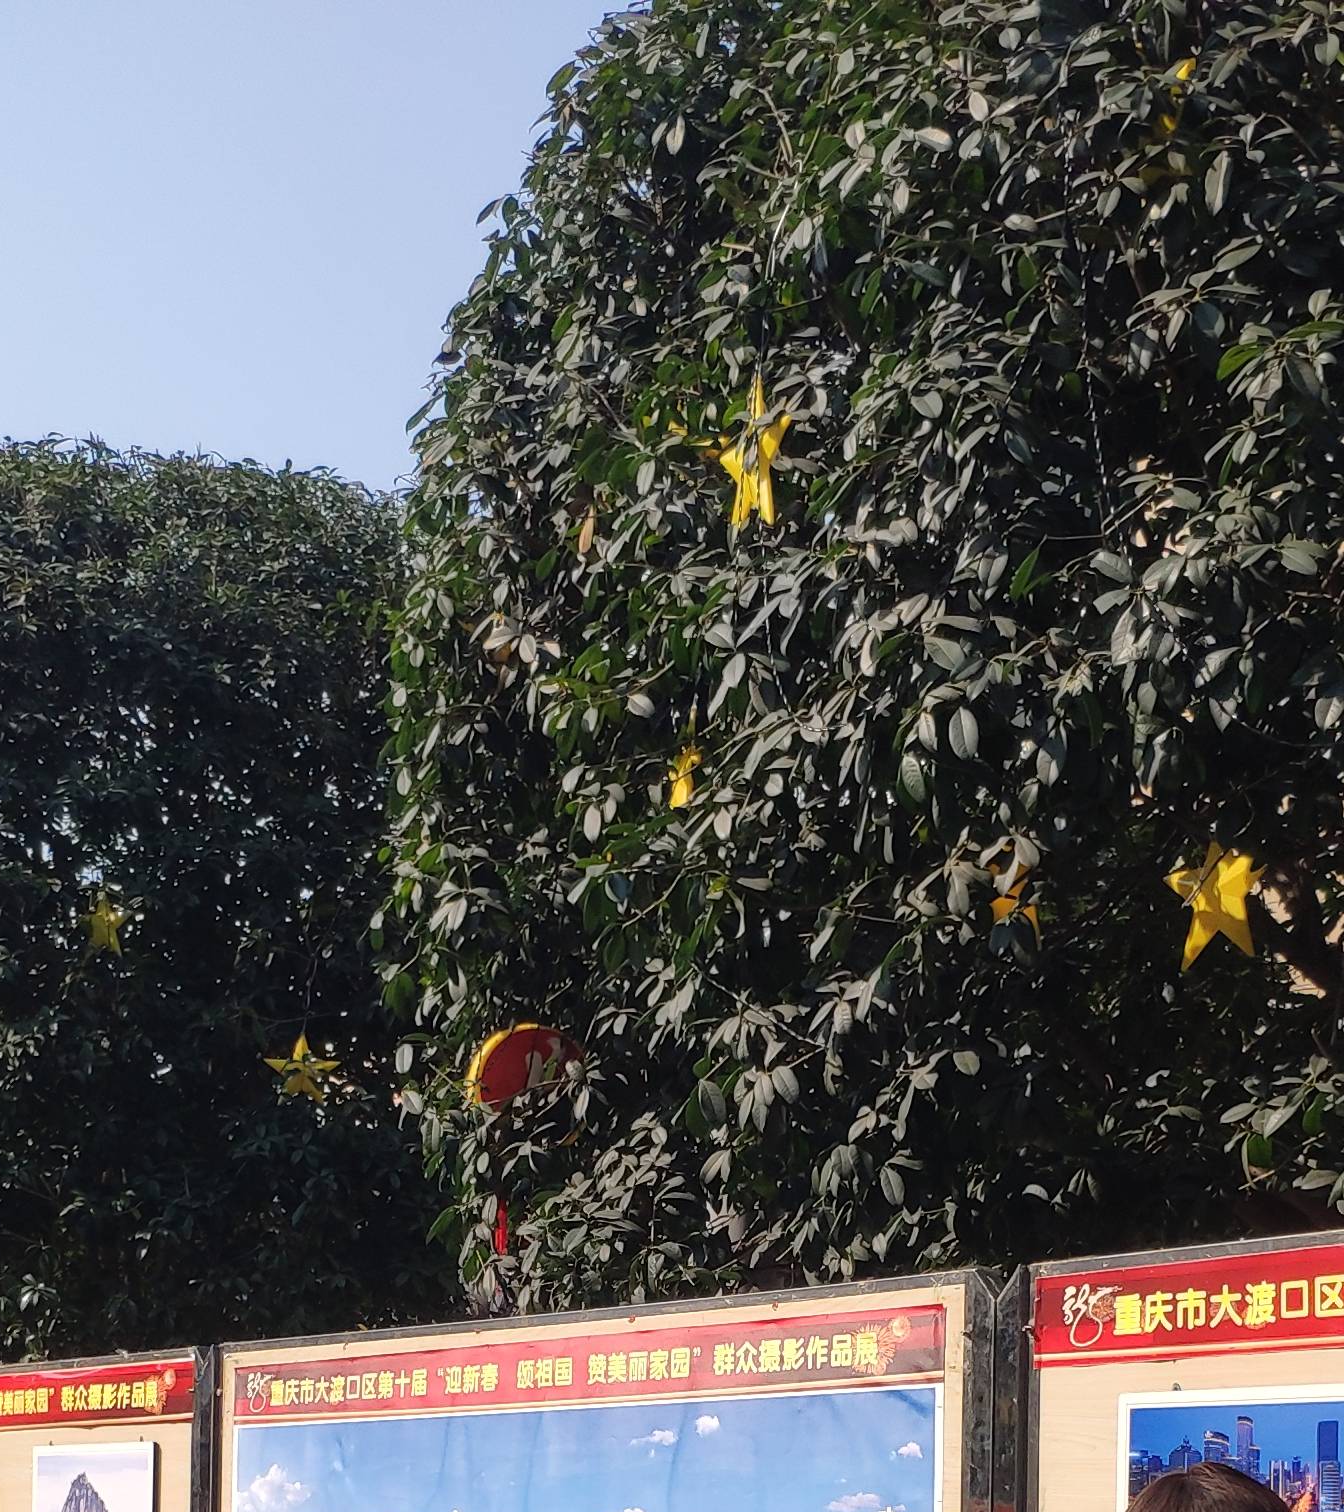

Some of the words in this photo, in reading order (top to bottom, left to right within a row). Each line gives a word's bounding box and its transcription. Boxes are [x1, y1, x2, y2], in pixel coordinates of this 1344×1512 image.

[269, 1368, 428, 1407] 重庆市大渡口区第十届
[516, 1356, 574, 1389] 颂祖国
[587, 1347, 702, 1385] 赞美丽家园”
[712, 1331, 878, 1376] 群众摄影作品展
